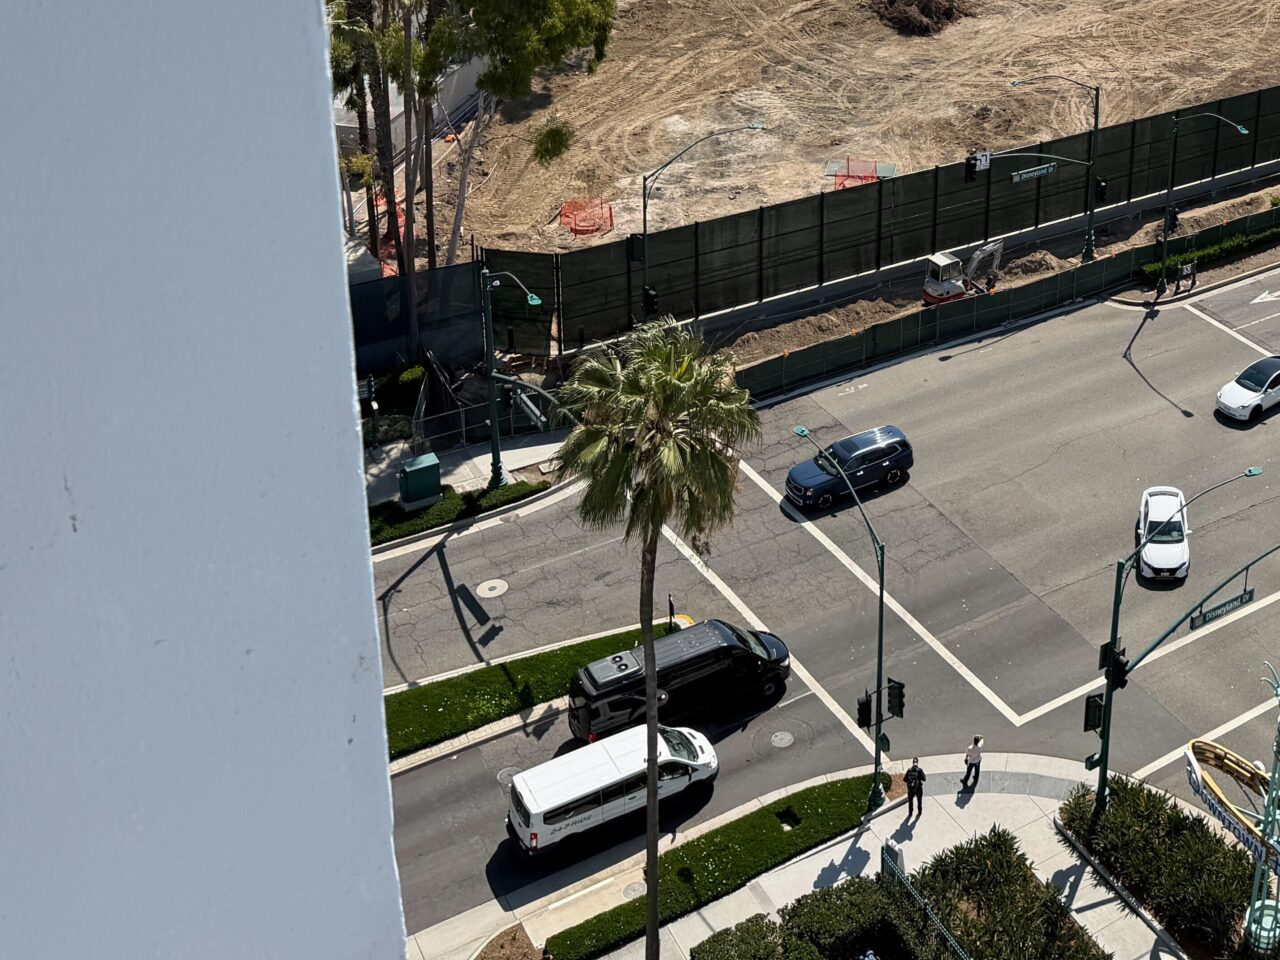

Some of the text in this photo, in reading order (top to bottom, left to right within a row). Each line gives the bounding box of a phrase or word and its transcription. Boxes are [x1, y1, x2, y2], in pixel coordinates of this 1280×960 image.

[1021, 167, 1048, 180] Disneyland
[1205, 593, 1250, 621] Disneyland Dr
[1186, 759, 1264, 862] DOWNTOWN
